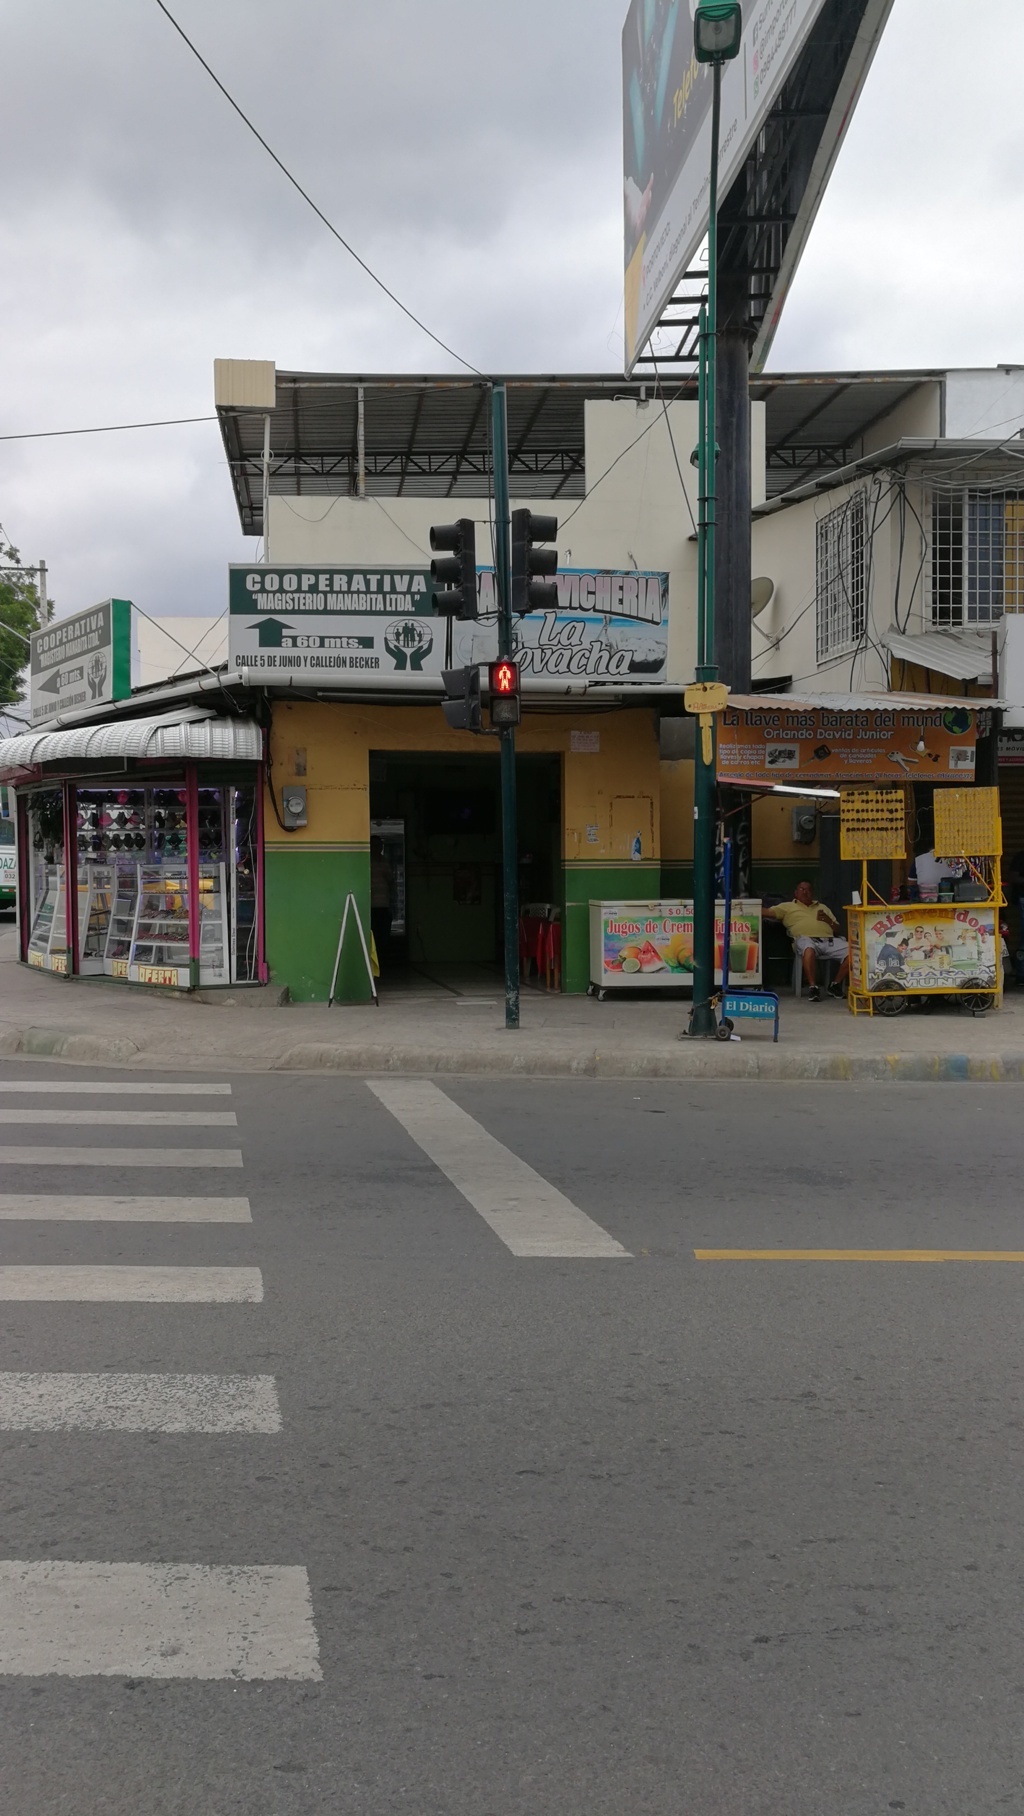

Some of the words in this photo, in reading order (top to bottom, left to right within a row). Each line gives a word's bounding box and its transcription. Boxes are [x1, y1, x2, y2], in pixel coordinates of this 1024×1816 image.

[245, 573, 427, 592] COOPERATIVA
[326, 593, 385, 612] MANABITA
[532, 573, 663, 625] VICHERIA
[36, 611, 104, 654] COOPERATIVA
[538, 611, 586, 647] La
[281, 638, 292, 648] a
[296, 635, 321, 648] 60
[324, 636, 363, 649] mts.
[235, 655, 258, 667] CALLE
[260, 655, 266, 667] 5
[267, 655, 278, 667] DE
[278, 655, 301, 668] JUNIO
[302, 656, 308, 667] Y
[309, 653, 347, 669] CALLEJÓN
[349, 656, 380, 669] BECKER
[511, 640, 634, 675] ovacha
[722, 711, 739, 727] La
[745, 711, 780, 727] llave
[786, 711, 816, 727] más
[821, 712, 869, 728] barata
[874, 711, 896, 728] del
[763, 728, 814, 739] Orlando
[817, 728, 853, 739] David
[857, 728, 894, 739] Junior
[607, 917, 641, 936] Jugos
[645, 918, 659, 934] de
[662, 917, 694, 934] Crem
[139, 967, 178, 986] OFERTA
[868, 971, 908, 979] MAS
[910, 969, 990, 978] BARATA
[726, 1001, 736, 1011] El
[740, 1001, 776, 1013] Diario
